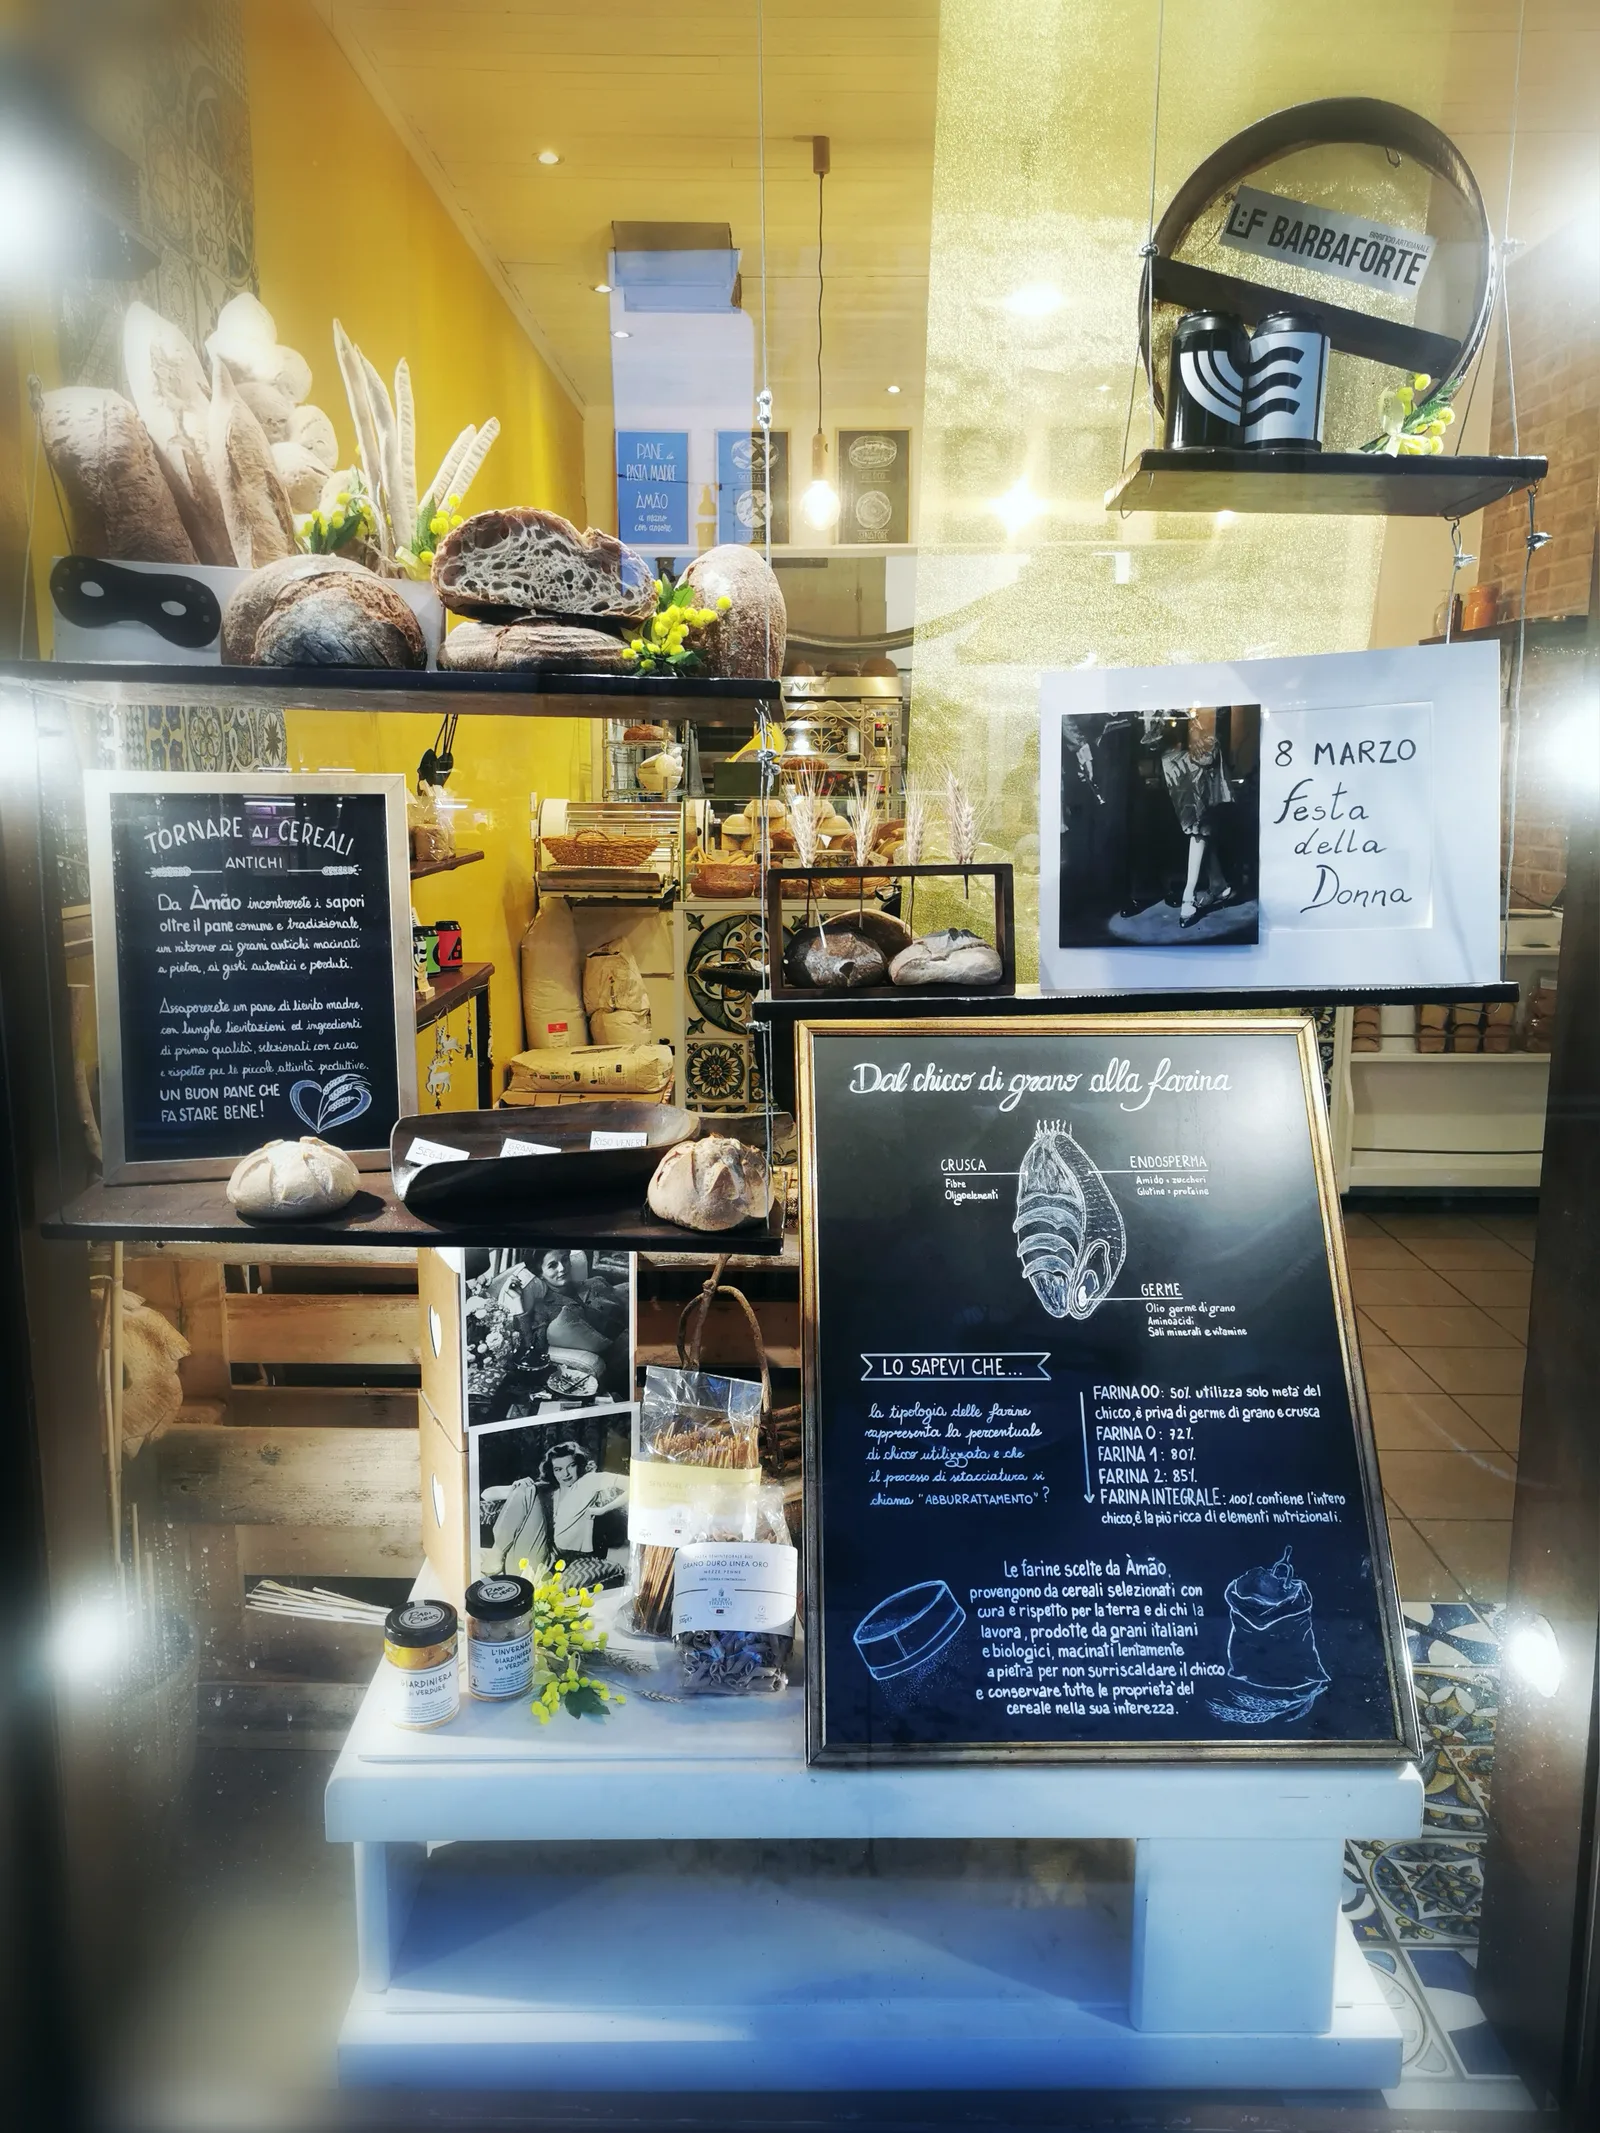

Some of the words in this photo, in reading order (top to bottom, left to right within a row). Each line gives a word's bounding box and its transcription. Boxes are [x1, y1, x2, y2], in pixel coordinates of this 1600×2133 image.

[1268, 216, 1426, 286] BARBAFORTE
[637, 443, 664, 460] PANE
[627, 464, 648, 481] PASTA
[651, 465, 676, 481] MADRE
[636, 491, 668, 509] ÀMÃO
[649, 524, 672, 532] amore
[1275, 740, 1292, 766] 8
[1314, 739, 1416, 765] MARZO
[144, 817, 243, 853] TORNARE
[252, 826, 268, 839] AI
[278, 820, 354, 856] CEREALI
[1294, 828, 1387, 855] della
[225, 857, 282, 869] ANTICHI
[1300, 865, 1412, 913] Donna
[158, 894, 181, 911] Da
[190, 885, 241, 910] Àmão
[247, 895, 311, 910] incontrerete
[314, 898, 321, 909] i
[326, 895, 364, 911] sapori
[160, 918, 190, 932] oltre
[193, 918, 200, 932] il
[205, 920, 233, 935] pane
[236, 922, 273, 931] comune
[277, 923, 283, 931] e
[160, 998, 230, 1018] Assaporerete
[233, 1003, 247, 1012] un
[250, 1004, 275, 1016] pane
[278, 1000, 291, 1012] di
[293, 997, 323, 1011] lievito
[160, 1089, 180, 1101] UN
[185, 1087, 218, 1100] BUON
[224, 1085, 255, 1098] PANE
[259, 1084, 280, 1097] CHE
[850, 1062, 909, 1093] Dal
[912, 1063, 977, 1092] chicco
[980, 1066, 1004, 1092] di
[999, 1072, 1082, 1112] grano
[1089, 1058, 1142, 1093] alla
[1120, 1058, 1232, 1111] farina
[162, 1109, 177, 1122] FA
[179, 1106, 218, 1122] STARE
[224, 1100, 264, 1120] BENE!
[941, 1159, 987, 1171] CRUSCA
[1130, 1155, 1207, 1168] ENDOSPERMA
[945, 1179, 966, 1188] Fibre
[1136, 1175, 1163, 1185] Amido
[1172, 1176, 1206, 1184] zuccheri
[945, 1189, 998, 1206] Oligoelementi
[1137, 1187, 1165, 1196] Glutine
[1174, 1186, 1209, 1197] proteine
[1141, 1283, 1182, 1296] GERME
[1146, 1303, 1164, 1313] Olio
[1169, 1305, 1196, 1317] germe
[1199, 1302, 1207, 1312] di
[1210, 1305, 1236, 1318] grano
[1148, 1316, 1194, 1325] Aminoacidi
[1149, 1327, 1164, 1337] Sali
[1167, 1328, 1200, 1336] minerali
[1212, 1328, 1247, 1336] vitamine
[883, 1359, 903, 1375] LO
[910, 1358, 964, 1375] SAPEVI
[972, 1358, 1022, 1375] CHE...
[1093, 1385, 1140, 1400] FARINA
[1141, 1384, 1164, 1399] 00:
[1170, 1386, 1191, 1399] 50%
[1196, 1386, 1242, 1398] utilizza
[1246, 1385, 1269, 1397] solo
[1272, 1385, 1299, 1397] metà
[1304, 1384, 1321, 1397] del
[868, 1403, 884, 1418] la
[889, 1402, 947, 1425] tipologia
[951, 1404, 982, 1417] delle
[987, 1403, 1031, 1423] farine
[865, 1423, 941, 1443] rappresenta
[946, 1423, 961, 1438] la
[965, 1422, 1042, 1445] percentuale
[1096, 1426, 1143, 1441] FARINA
[1170, 1427, 1194, 1440] 72%
[1098, 1446, 1145, 1462] FARINA
[1171, 1449, 1196, 1461] 80%
[1099, 1468, 1149, 1484] FARINA
[1154, 1469, 1167, 1483] 2:
[1172, 1469, 1197, 1483] 85%
[870, 1493, 914, 1506] chiama
[1100, 1488, 1151, 1505] FARINA
[1151, 1487, 1226, 1506] INTEGRALE:
[1229, 1492, 1253, 1505] 100%
[1256, 1491, 1304, 1505] contiene
[1307, 1491, 1345, 1505] l'intero
[683, 1561, 703, 1569] GRANO
[1004, 1560, 1019, 1578] Le
[1021, 1559, 1061, 1577] farine
[1064, 1559, 1102, 1577] scelte
[1105, 1558, 1120, 1576] da
[970, 1585, 1041, 1603] provengono
[1044, 1583, 1059, 1598] da
[1062, 1582, 1103, 1598] cereali
[1107, 1581, 1175, 1597] selezionati
[1181, 1585, 1203, 1596] con
[981, 1625, 1027, 1641] lavora,
[1030, 1623, 1088, 1642] prodotte
[1091, 1621, 1107, 1638] da
[1110, 1621, 1147, 1643] grani
[1152, 1621, 1198, 1637] italiani
[491, 1636, 532, 1656] L'INVERNALE
[982, 1647, 990, 1658] e
[992, 1643, 1055, 1663] biologici,
[1058, 1643, 1114, 1658] macinati
[1118, 1641, 1184, 1657] lentamente
[495, 1647, 531, 1664] GIARDINIERA
[505, 1655, 530, 1670] VERDURE
[416, 1683, 446, 1696] VERDURE
[1007, 1701, 1051, 1715] cereale
[1055, 1701, 1086, 1714] nella
[1089, 1702, 1110, 1714] sua
[1114, 1699, 1178, 1715] interezza.
